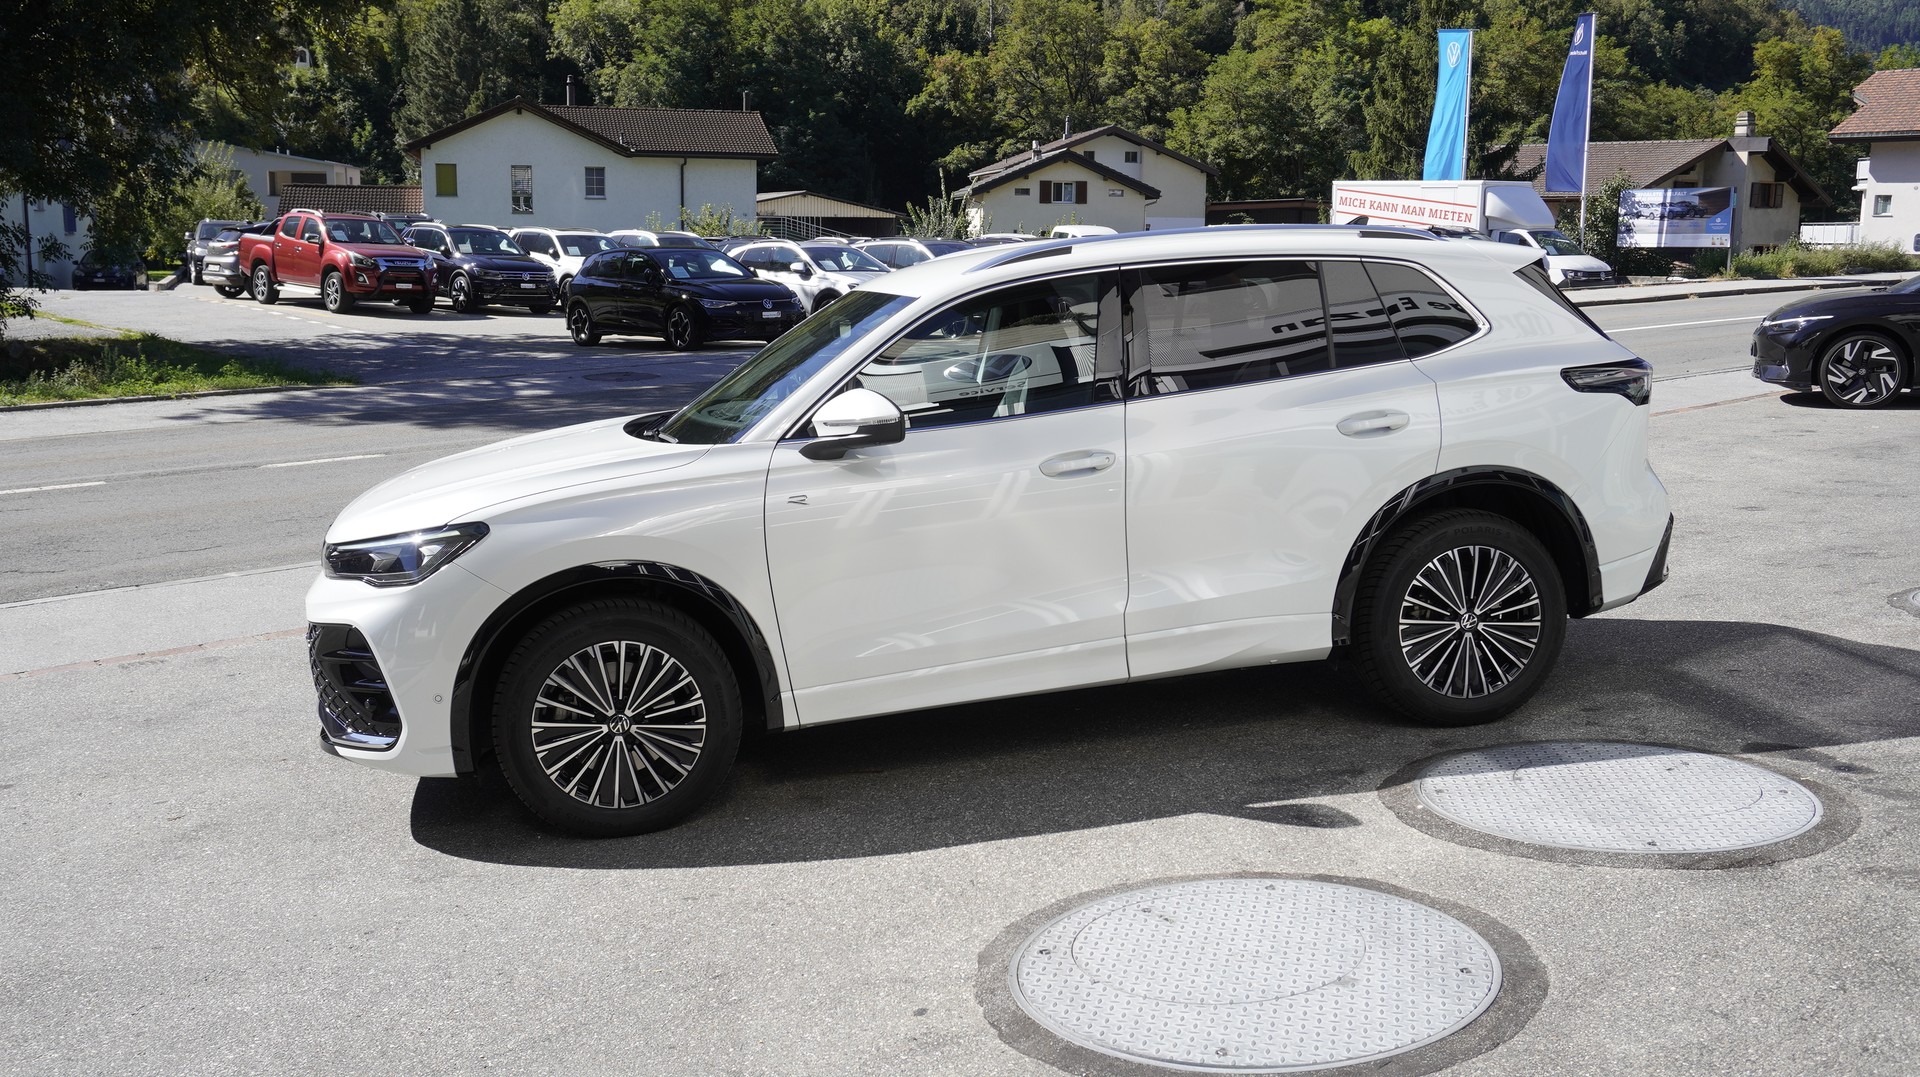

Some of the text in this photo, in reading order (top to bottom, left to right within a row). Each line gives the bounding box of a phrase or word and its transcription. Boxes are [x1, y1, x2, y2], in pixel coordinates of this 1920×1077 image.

[1339, 196, 1473, 223] MICH KANN MAN MIETEN
[1454, 526, 1503, 536] POLARIS
